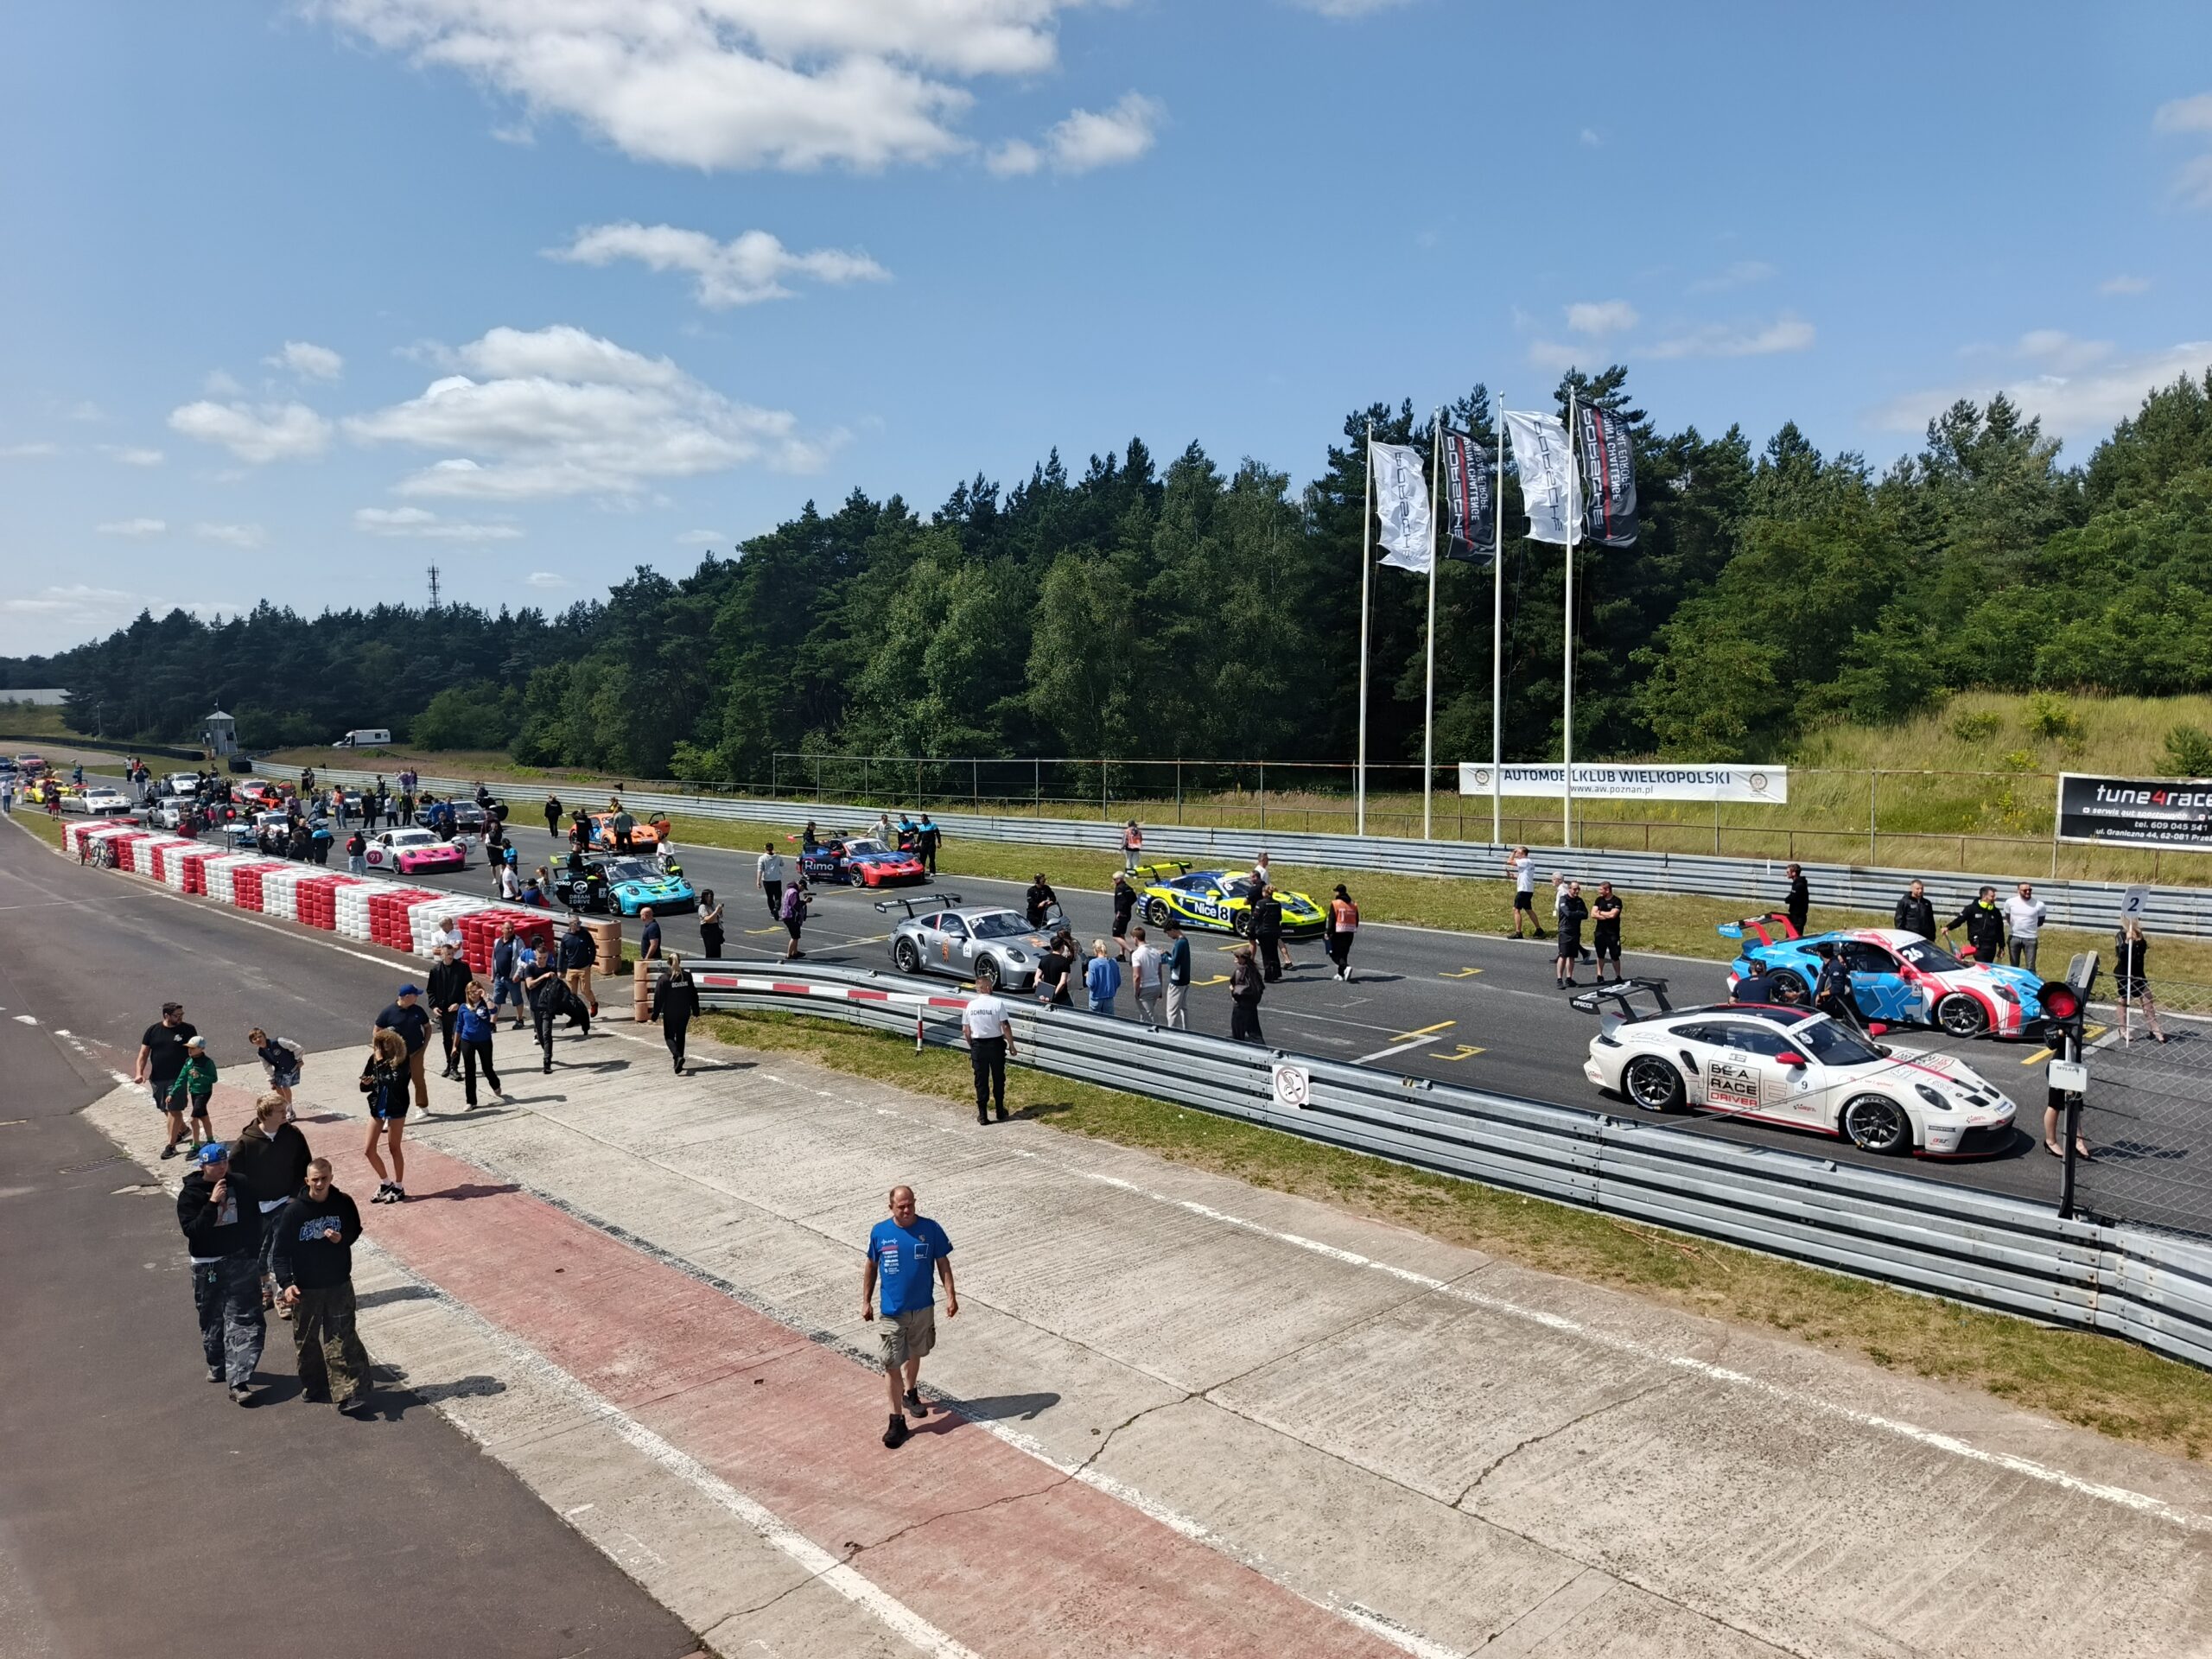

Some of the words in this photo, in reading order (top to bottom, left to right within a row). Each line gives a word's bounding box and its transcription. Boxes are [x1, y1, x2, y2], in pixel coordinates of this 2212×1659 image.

[1618, 770, 1731, 785] WIELKOPOLSKI
[1570, 785, 1654, 795] www.aw.poznan.pl
[2096, 784, 2212, 807] tune4race
[2092, 807, 2119, 816] serwis
[2136, 810, 2188, 821] sportowych
[2151, 821, 2168, 830] 609
[2171, 823, 2189, 831] 045
[2190, 823, 2208, 832] 541
[2107, 829, 2145, 838] Graniczna
[2160, 832, 2189, 842] 62-081
[370, 853, 380, 861] 91
[804, 860, 835, 871] Rimo
[1194, 901, 1217, 918] Nice
[2127, 897, 2139, 912] 2
[1220, 906, 1229, 920] 8
[971, 918, 985, 928] 54
[1902, 947, 1924, 963] 26
[1711, 1063, 1733, 1076] BE
[1738, 1070, 1749, 1079] A
[1711, 1077, 1757, 1096] RACE
[1801, 1080, 1808, 1090] 9
[1710, 1092, 1758, 1107] DRIVER
